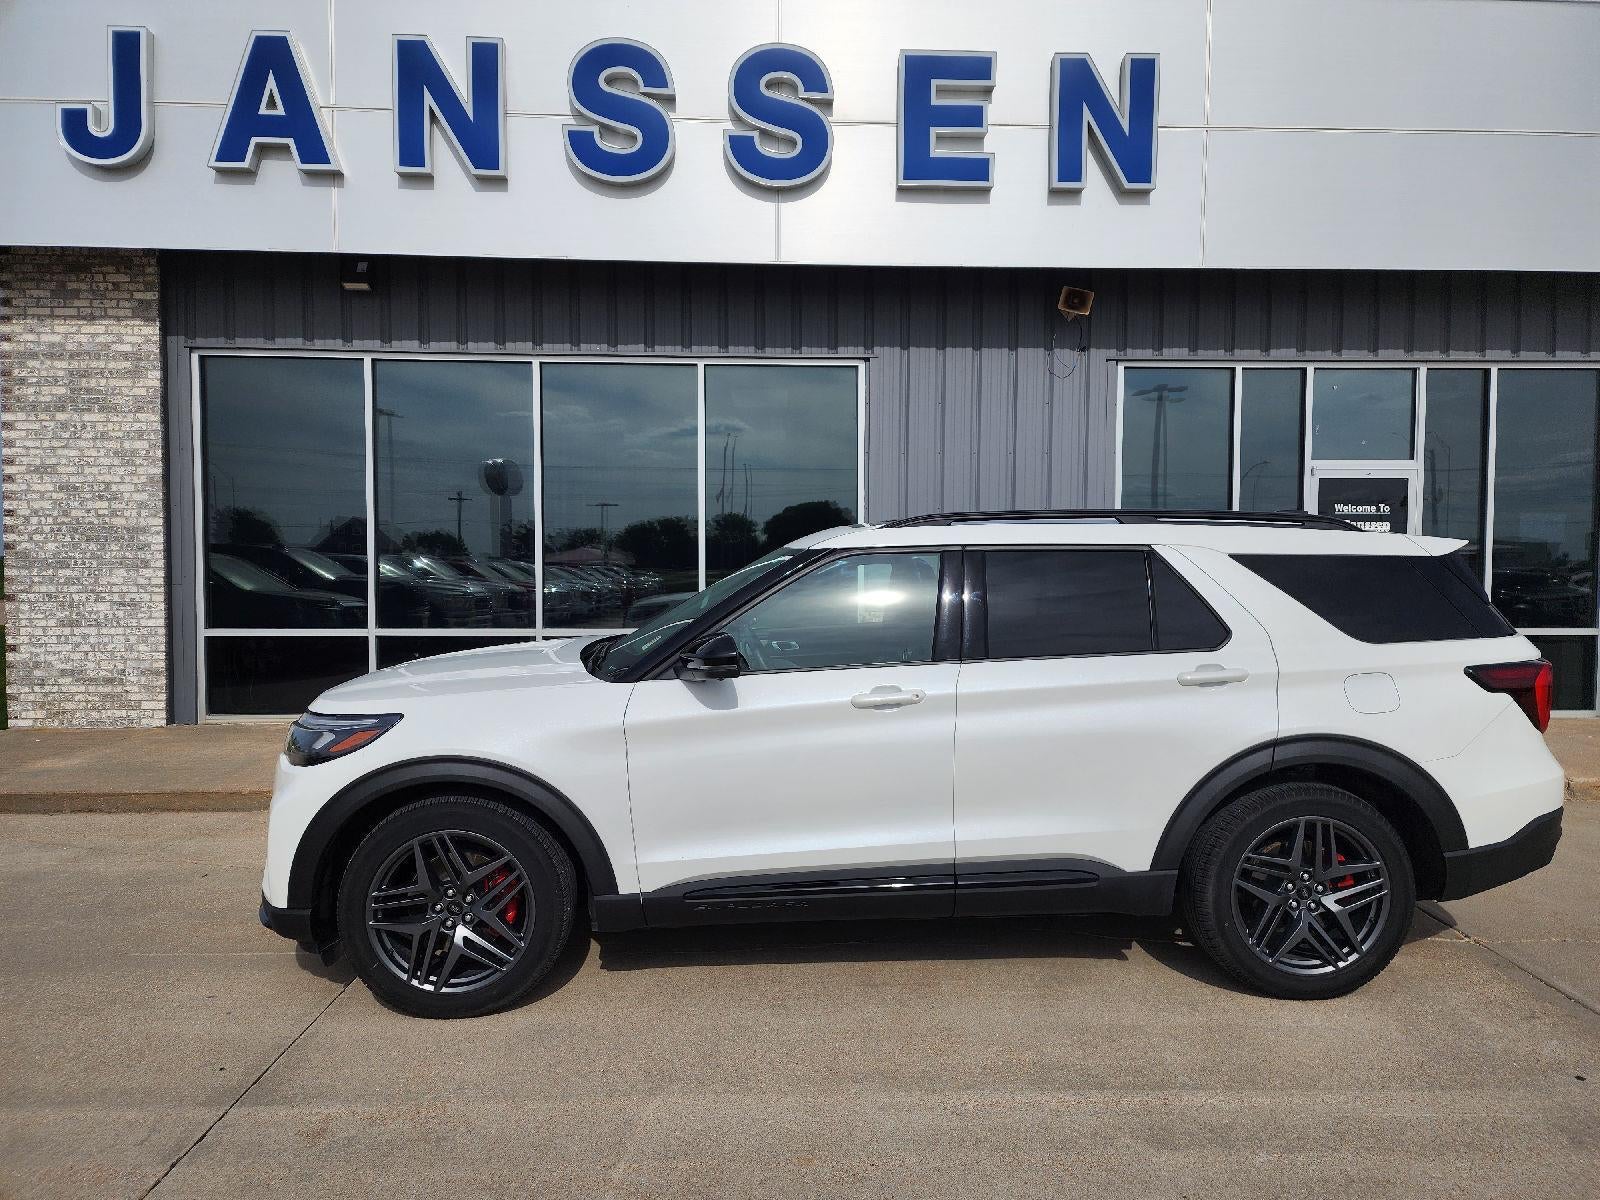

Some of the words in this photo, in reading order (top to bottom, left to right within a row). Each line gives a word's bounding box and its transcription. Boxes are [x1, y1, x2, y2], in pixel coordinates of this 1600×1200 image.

[55, 25, 1160, 191] JANSSEN
[1334, 503, 1376, 512] Welcome
[1378, 503, 1391, 512] To
[1344, 519, 1391, 532] nssen
